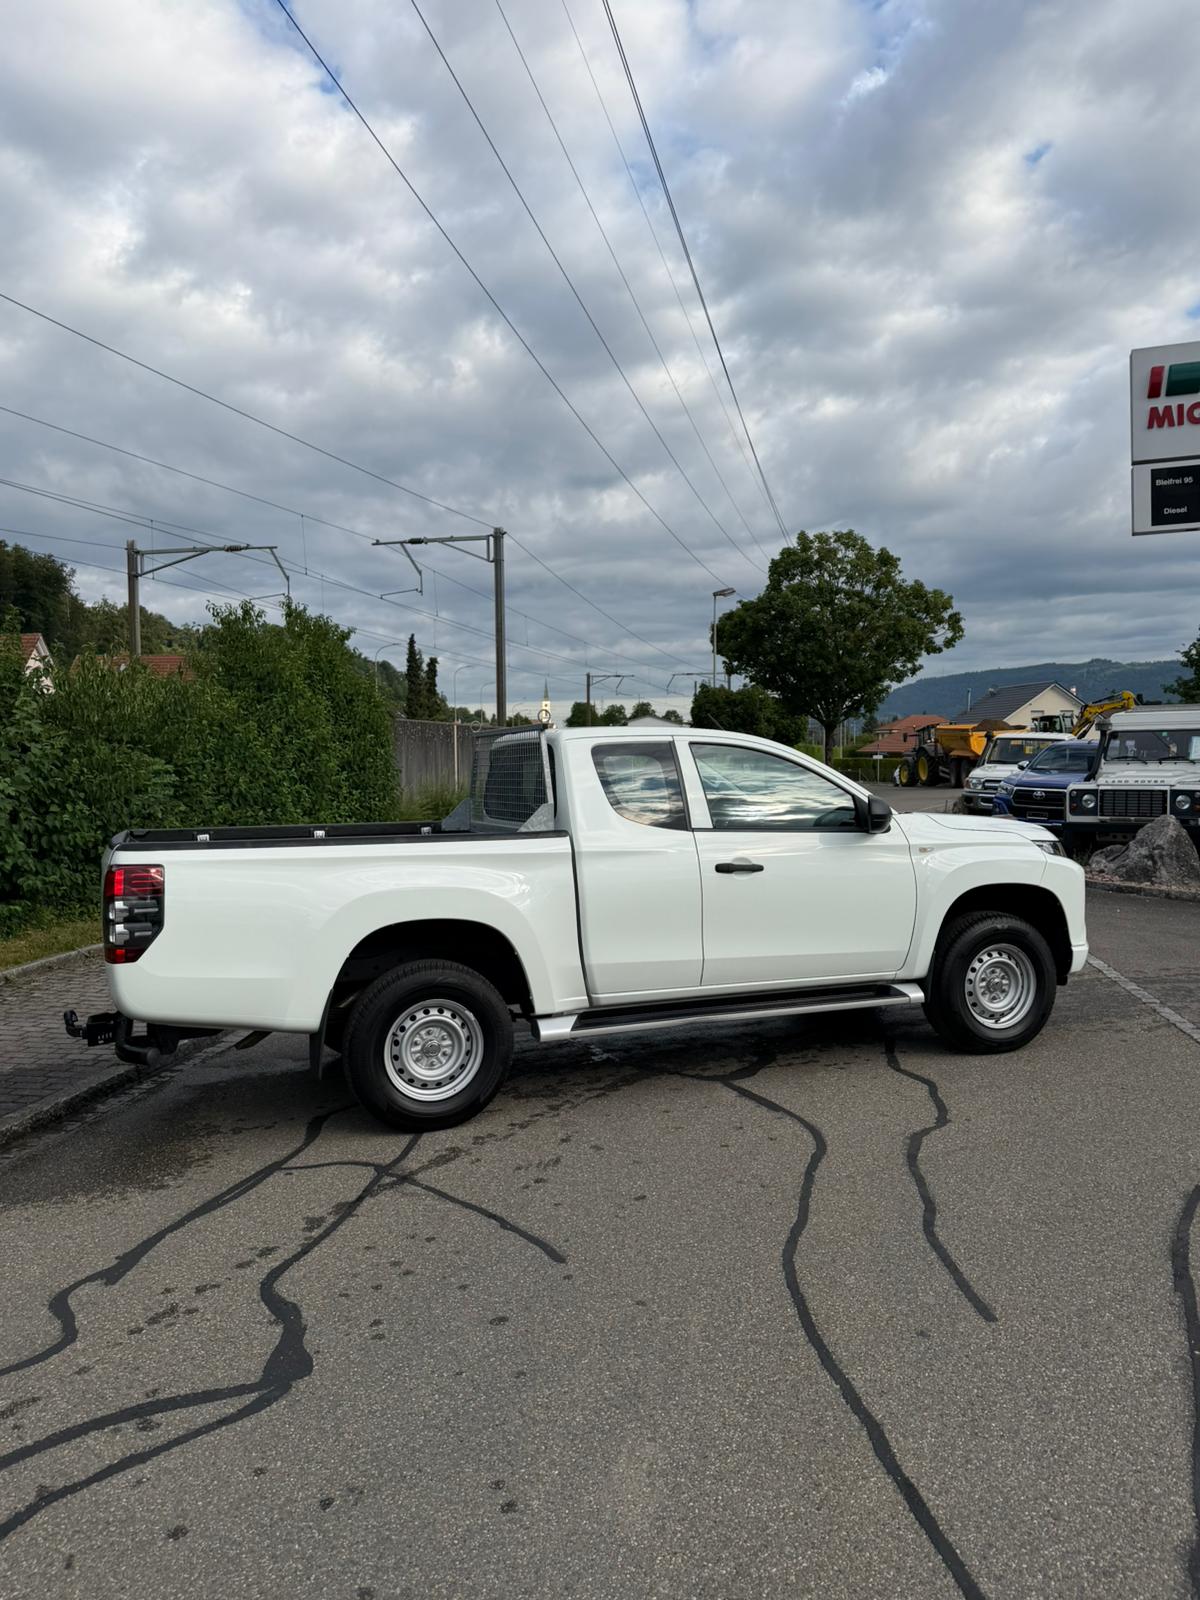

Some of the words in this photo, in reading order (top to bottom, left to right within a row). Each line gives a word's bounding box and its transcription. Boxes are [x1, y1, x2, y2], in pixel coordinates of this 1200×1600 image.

[1155, 477, 1182, 486] Bleifrei
[1183, 476, 1194, 484] 95
[1163, 505, 1188, 515] Diesel
